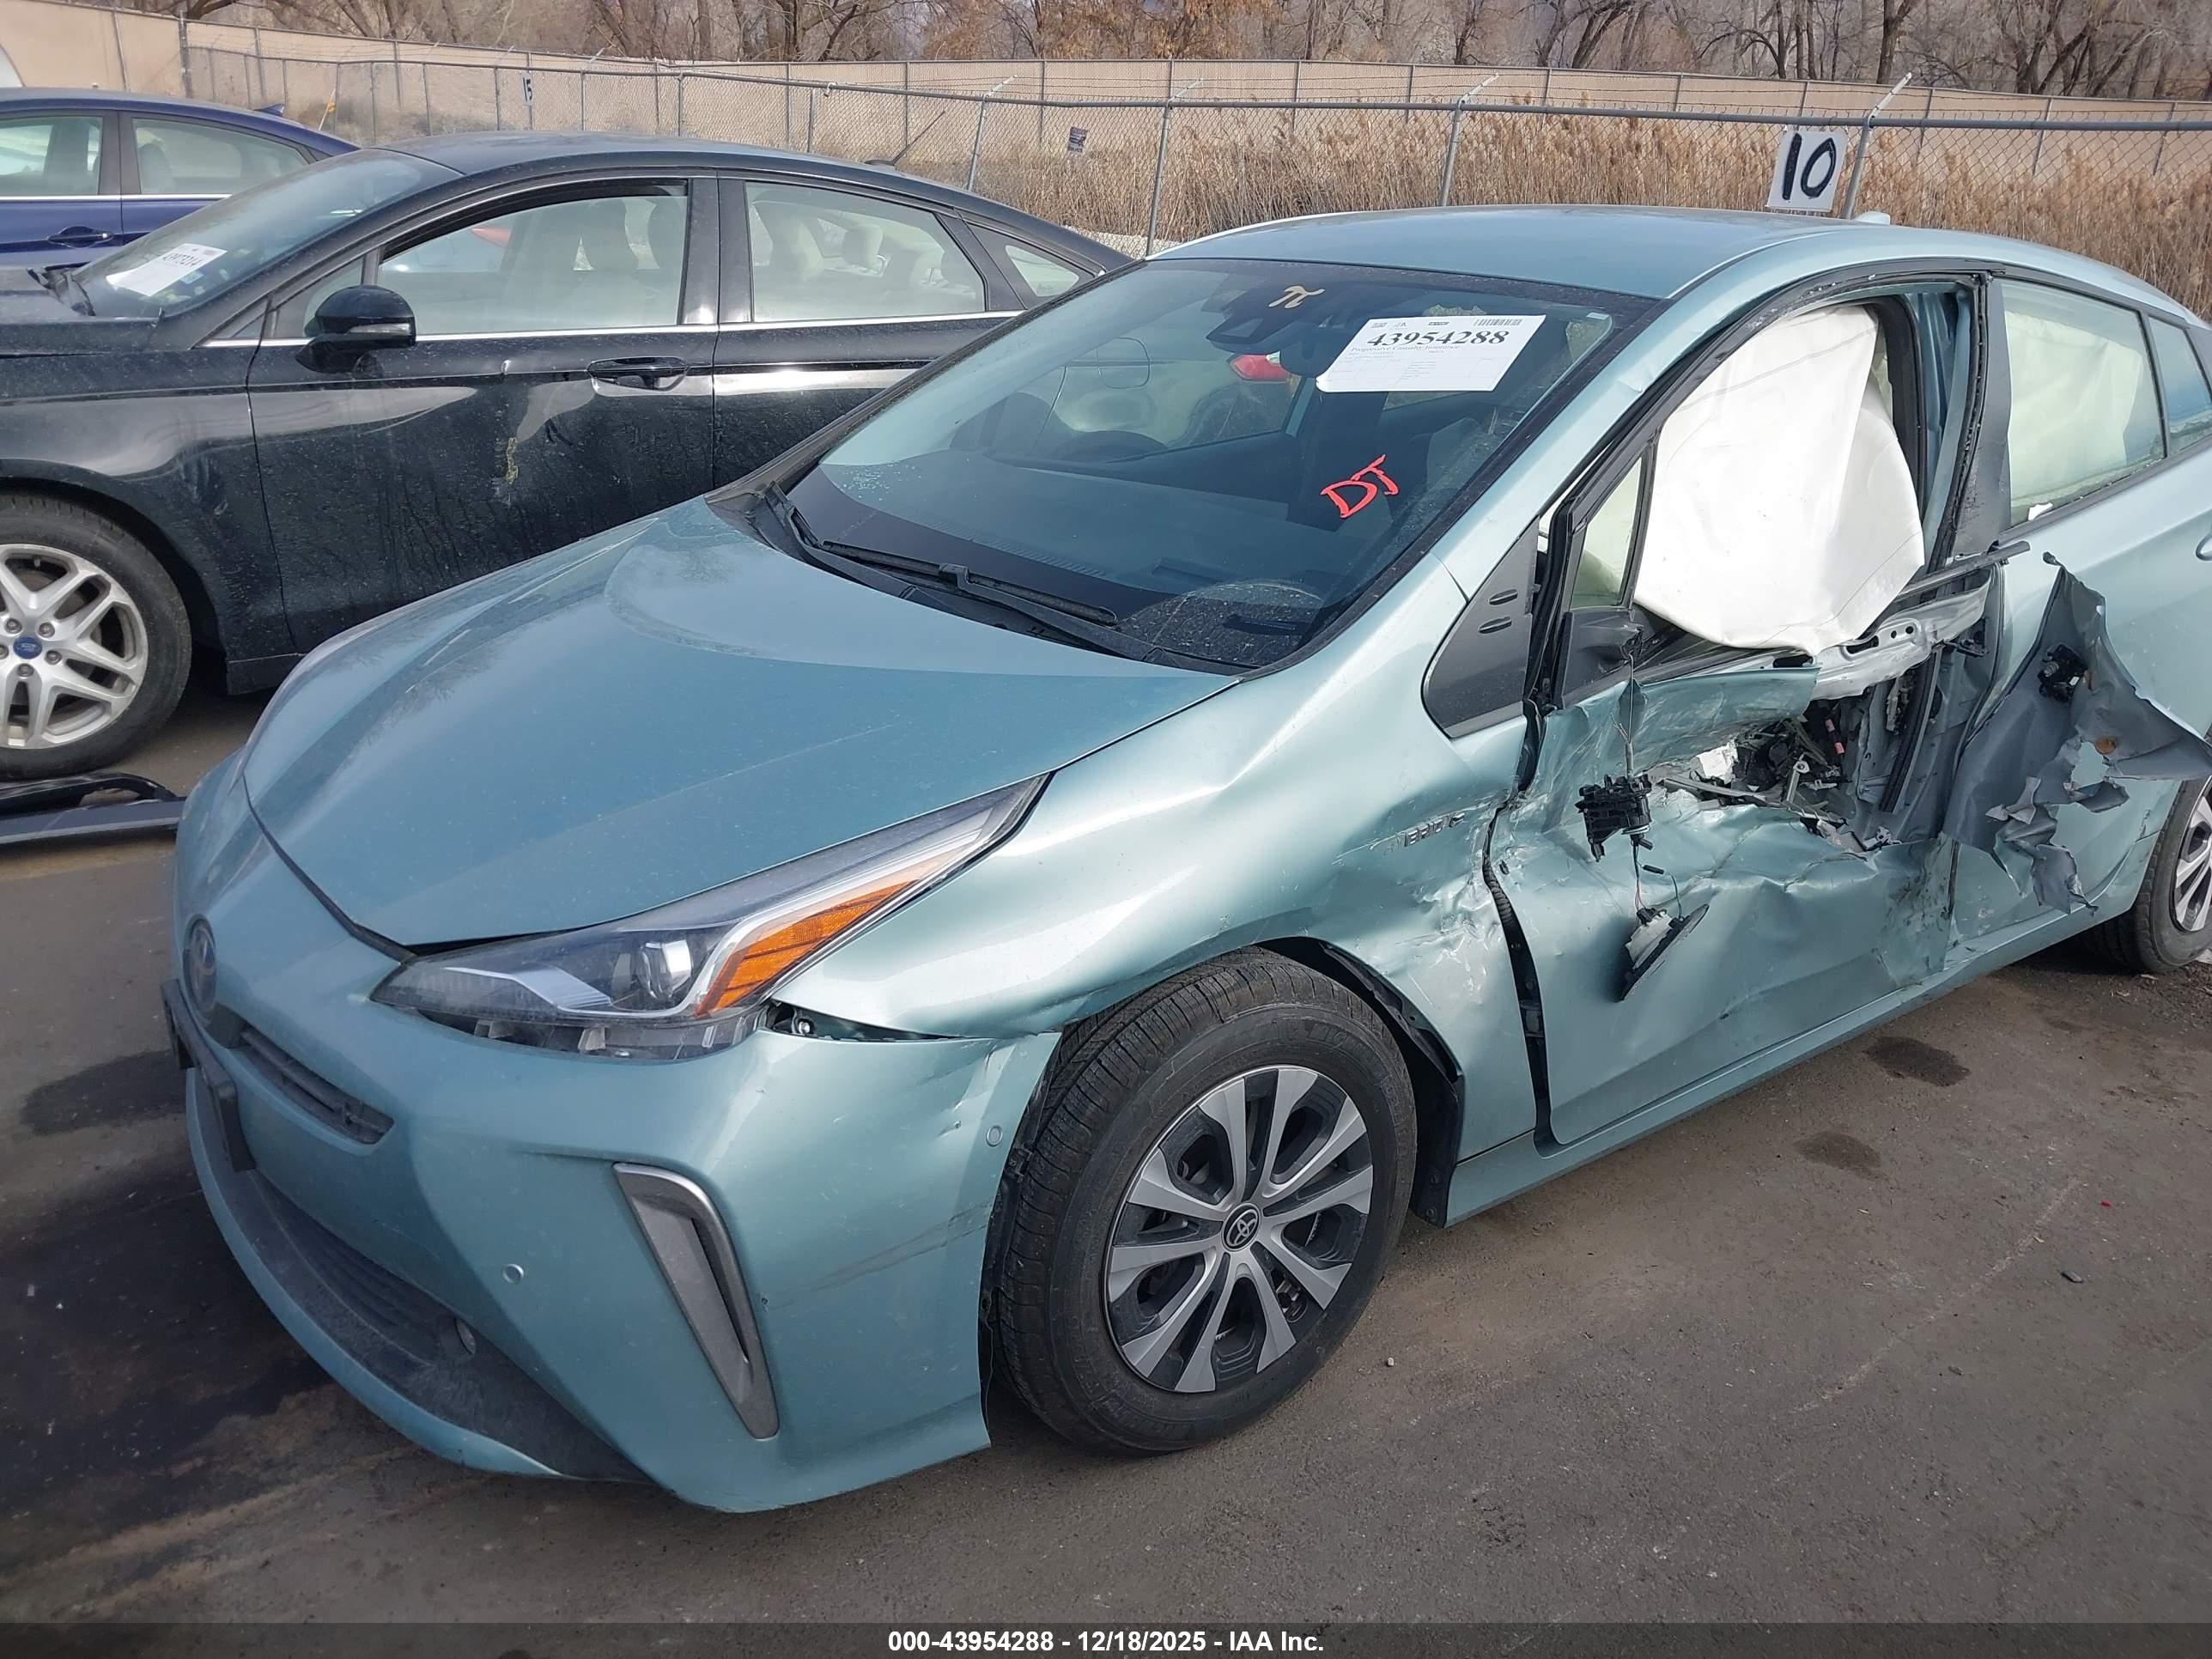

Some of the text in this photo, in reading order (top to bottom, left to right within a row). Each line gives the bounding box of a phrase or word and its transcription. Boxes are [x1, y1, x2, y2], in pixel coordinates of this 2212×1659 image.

[522, 76, 533, 102] 15
[1782, 132, 1837, 200] 10
[1367, 331, 1509, 346] 43954288
[1319, 453, 1400, 519] DT
